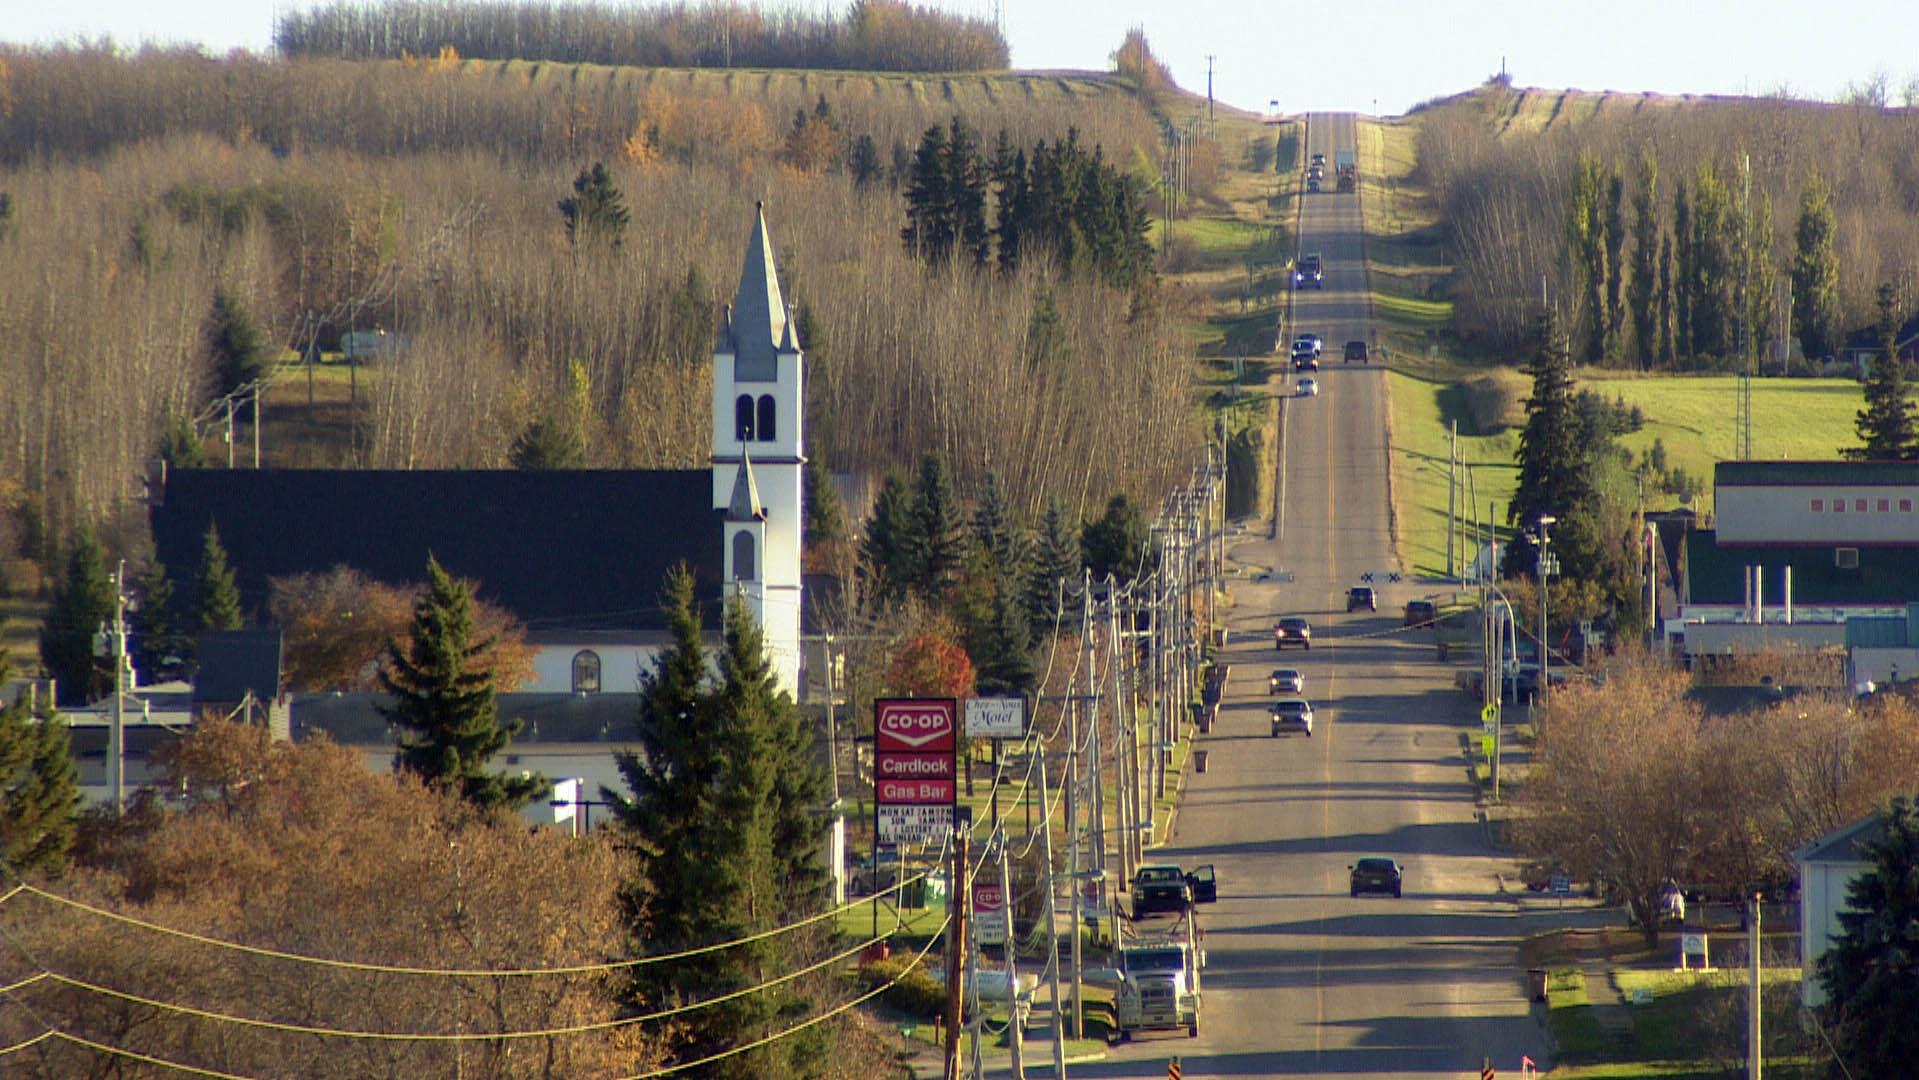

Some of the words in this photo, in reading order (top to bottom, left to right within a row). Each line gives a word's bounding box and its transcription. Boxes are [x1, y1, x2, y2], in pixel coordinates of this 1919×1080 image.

[887, 714, 944, 729] CO-OP
[972, 710, 1013, 727] Motel
[882, 759, 948, 773] Cardlock
[884, 784, 915, 799] Gas
[920, 784, 946, 799] Bar
